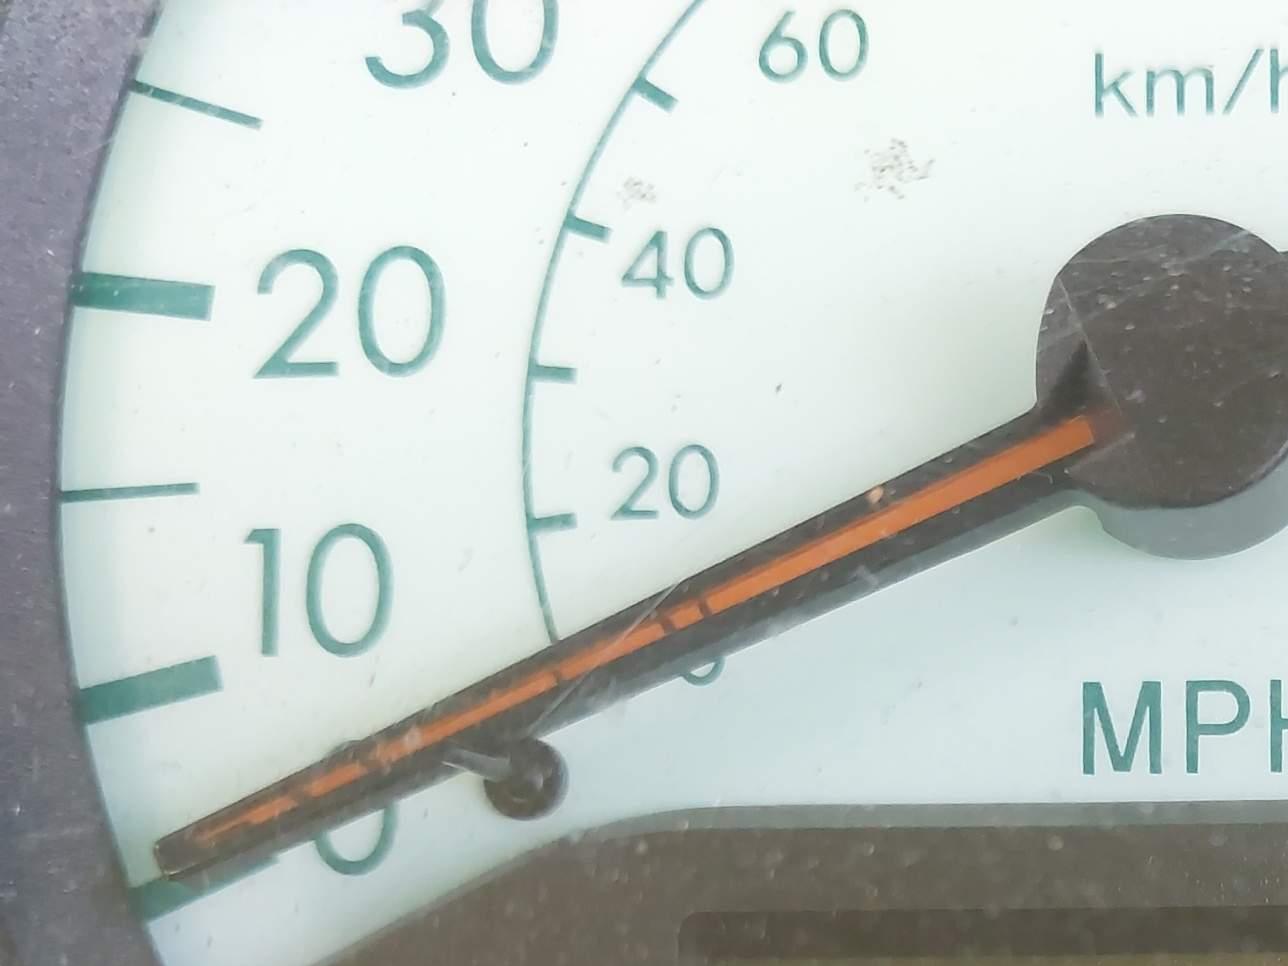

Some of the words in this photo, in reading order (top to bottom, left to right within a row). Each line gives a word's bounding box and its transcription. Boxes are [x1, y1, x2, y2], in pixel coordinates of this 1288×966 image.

[365, 0, 557, 88] 30
[758, 11, 868, 81] 60
[621, 228, 732, 299] 40
[253, 244, 444, 378] 20
[611, 446, 717, 518] 20
[243, 522, 392, 655] 10
